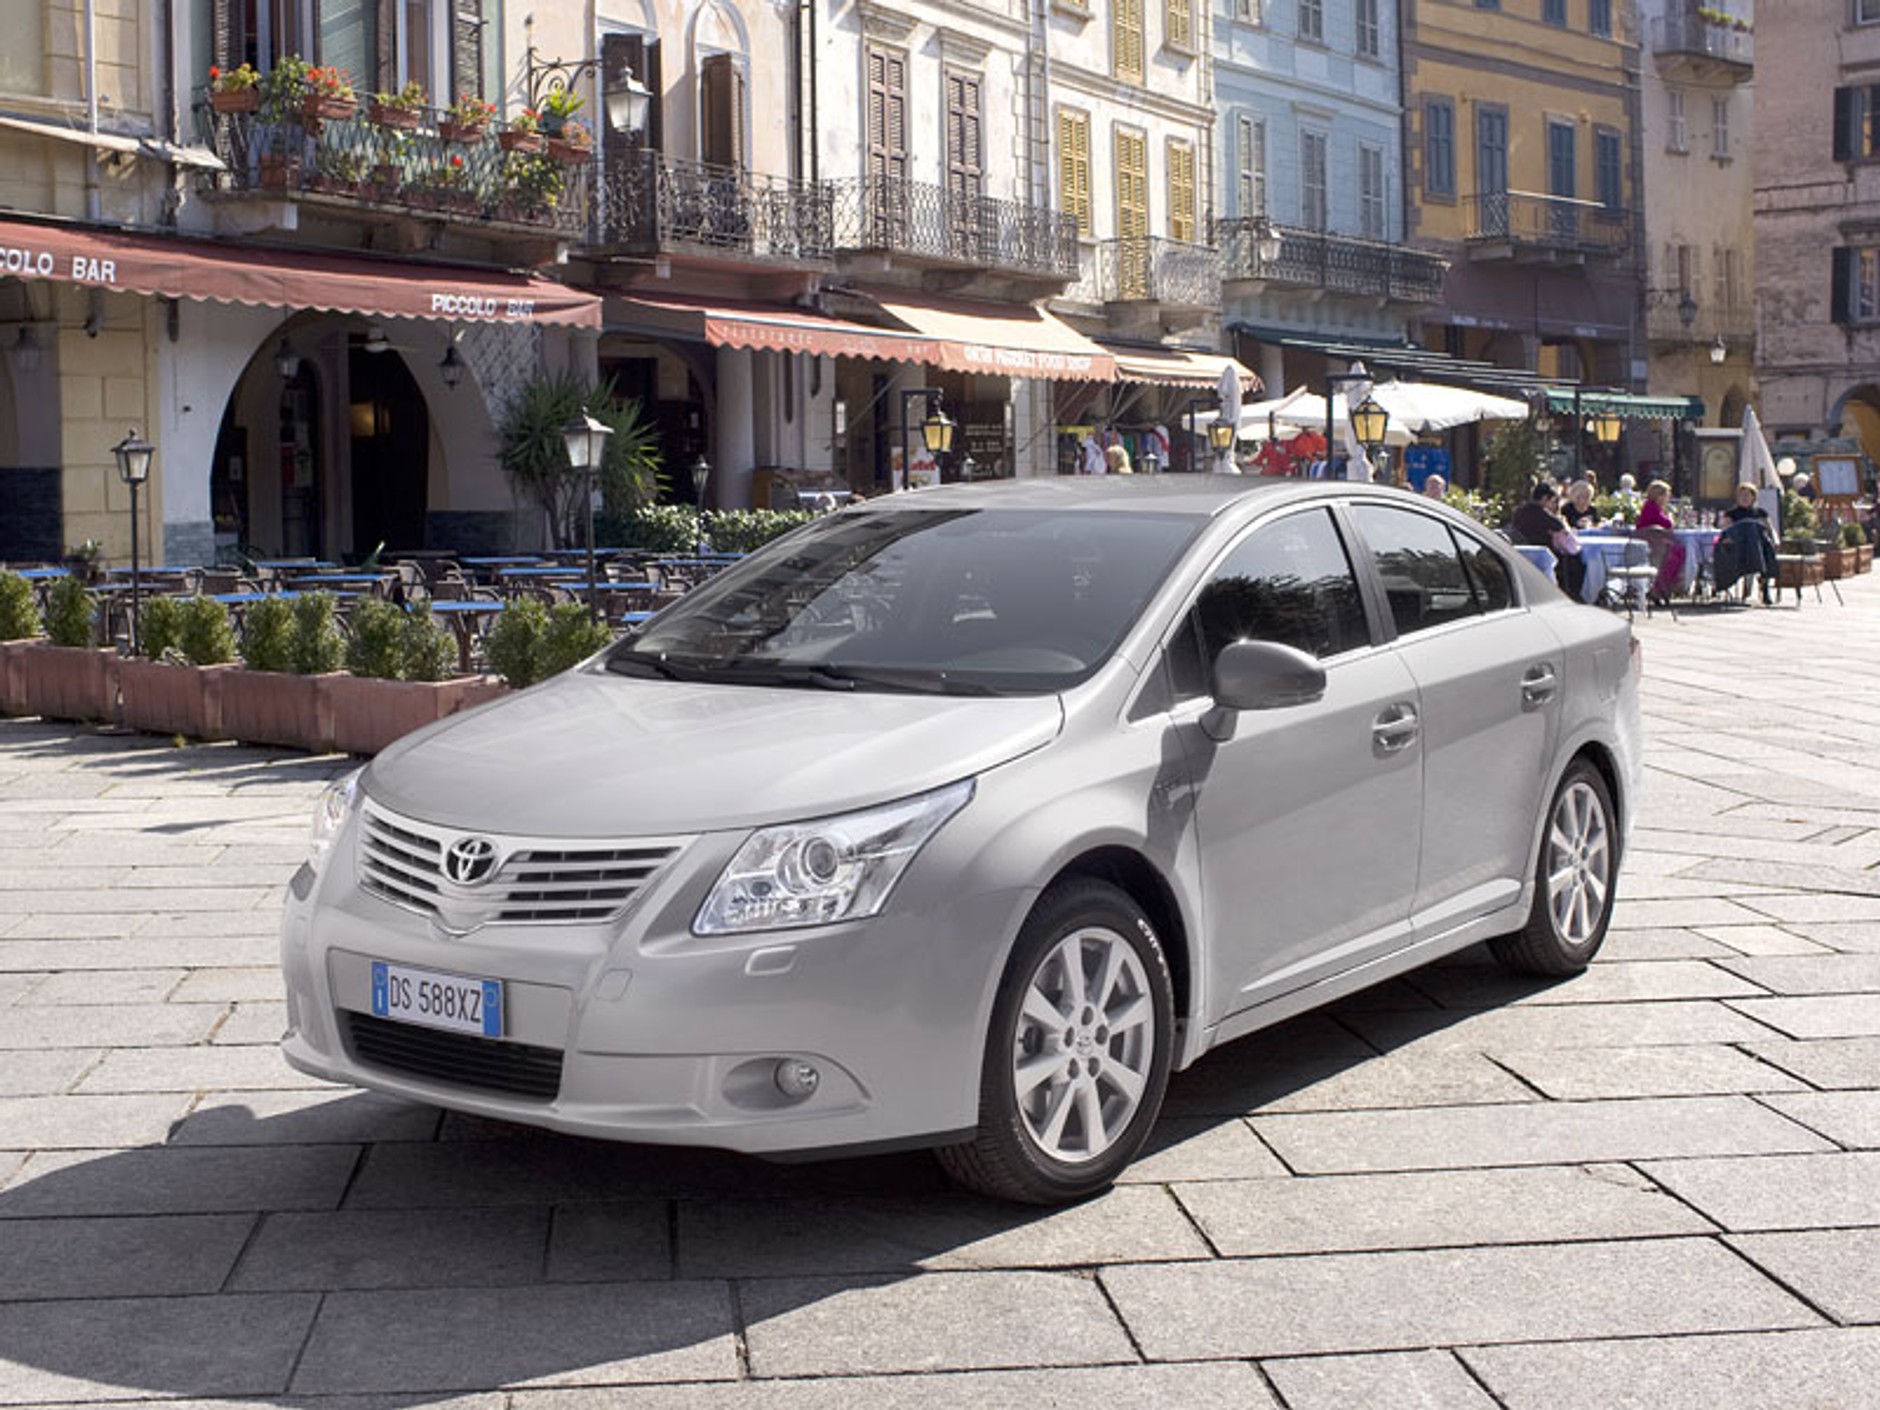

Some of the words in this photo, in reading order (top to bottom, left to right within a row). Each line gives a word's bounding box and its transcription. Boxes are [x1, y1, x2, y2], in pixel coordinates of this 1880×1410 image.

[72, 256, 117, 283] BAR
[431, 294, 497, 317] PICCOLO
[390, 975, 412, 1010] DS
[419, 980, 482, 1023] 588XZ
